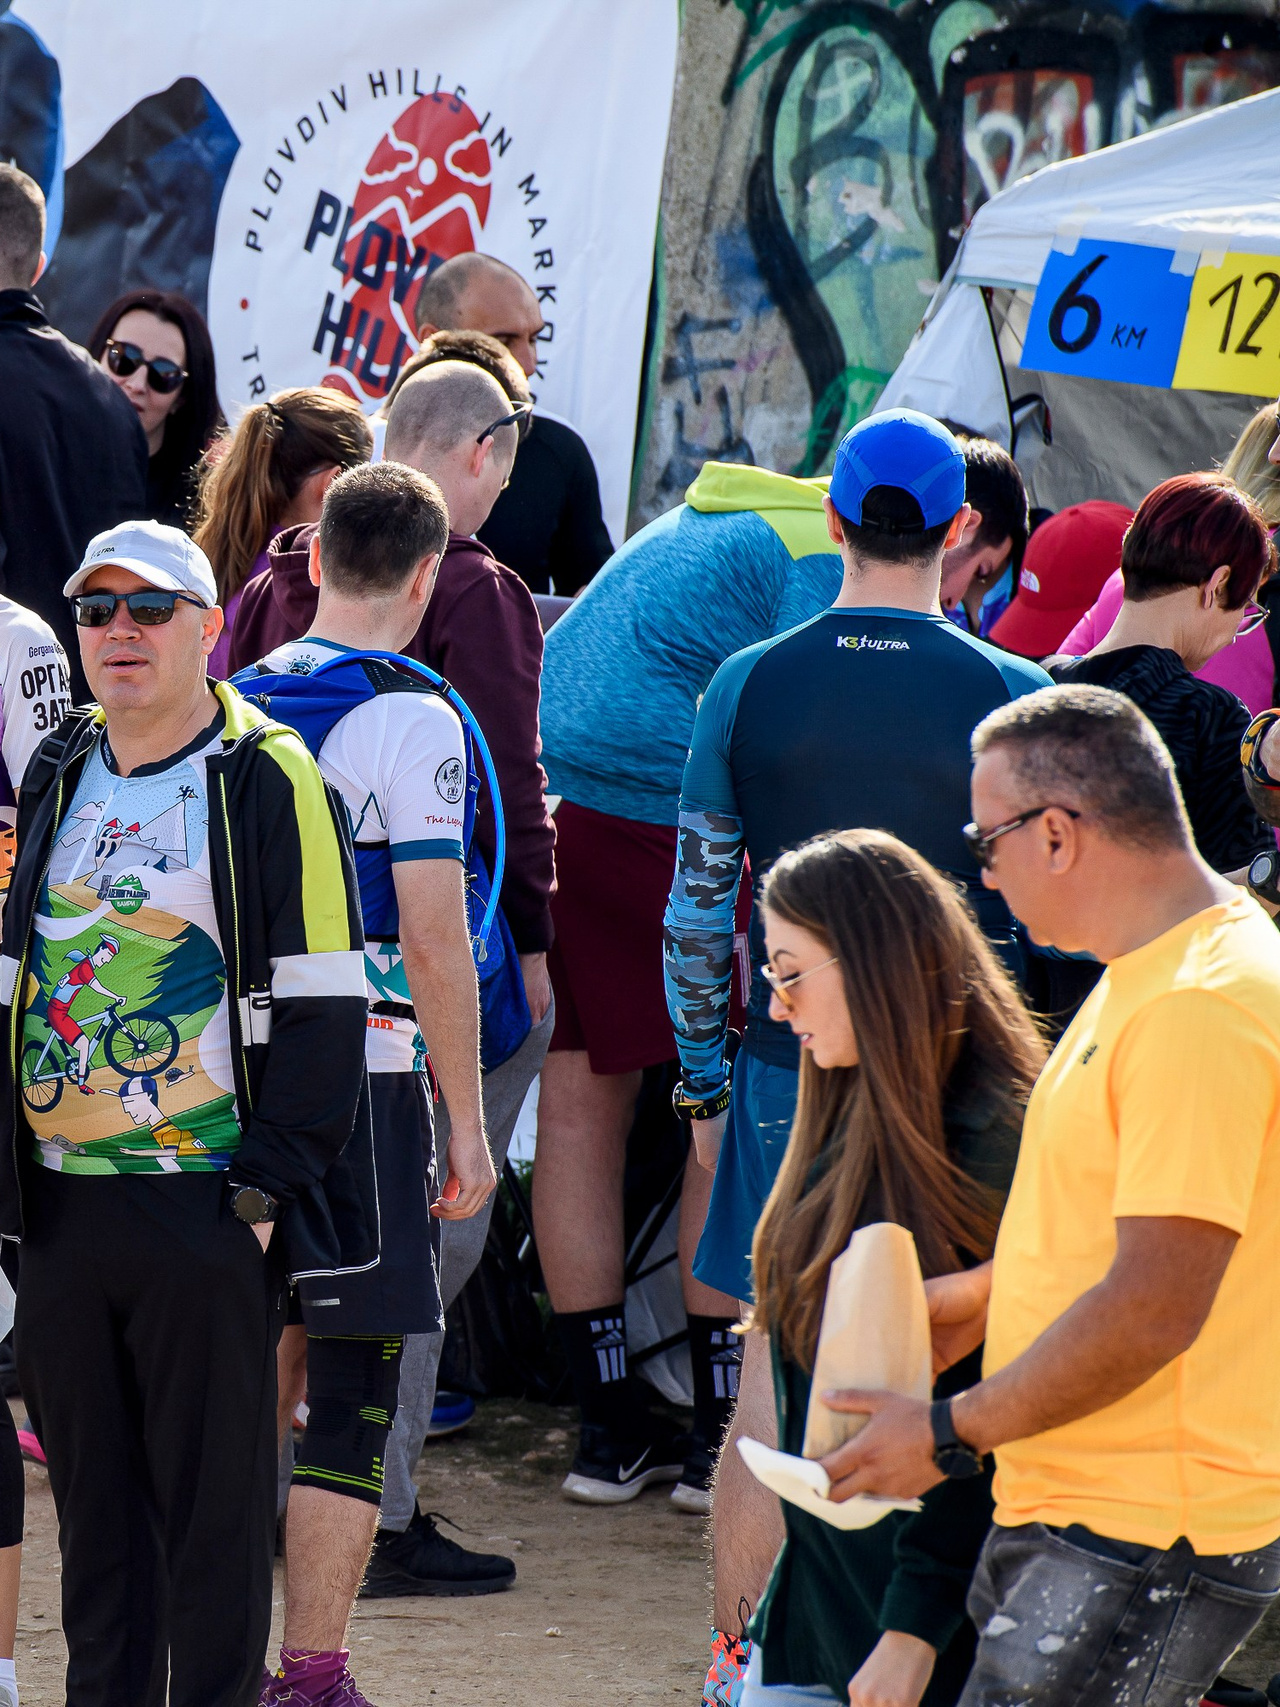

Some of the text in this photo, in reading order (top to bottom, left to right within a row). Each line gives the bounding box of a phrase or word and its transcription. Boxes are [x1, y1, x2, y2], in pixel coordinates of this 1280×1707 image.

[245, 84, 346, 252] PLOVDIV
[368, 68, 467, 114] HILLS
[477, 111, 512, 158] IN
[1048, 254, 1109, 354] 6
[1209, 271, 1280, 357] 12
[28, 645, 54, 658] Gergana
[837, 636, 910, 650] K3 ULTRA
[425, 815, 445, 824] The
